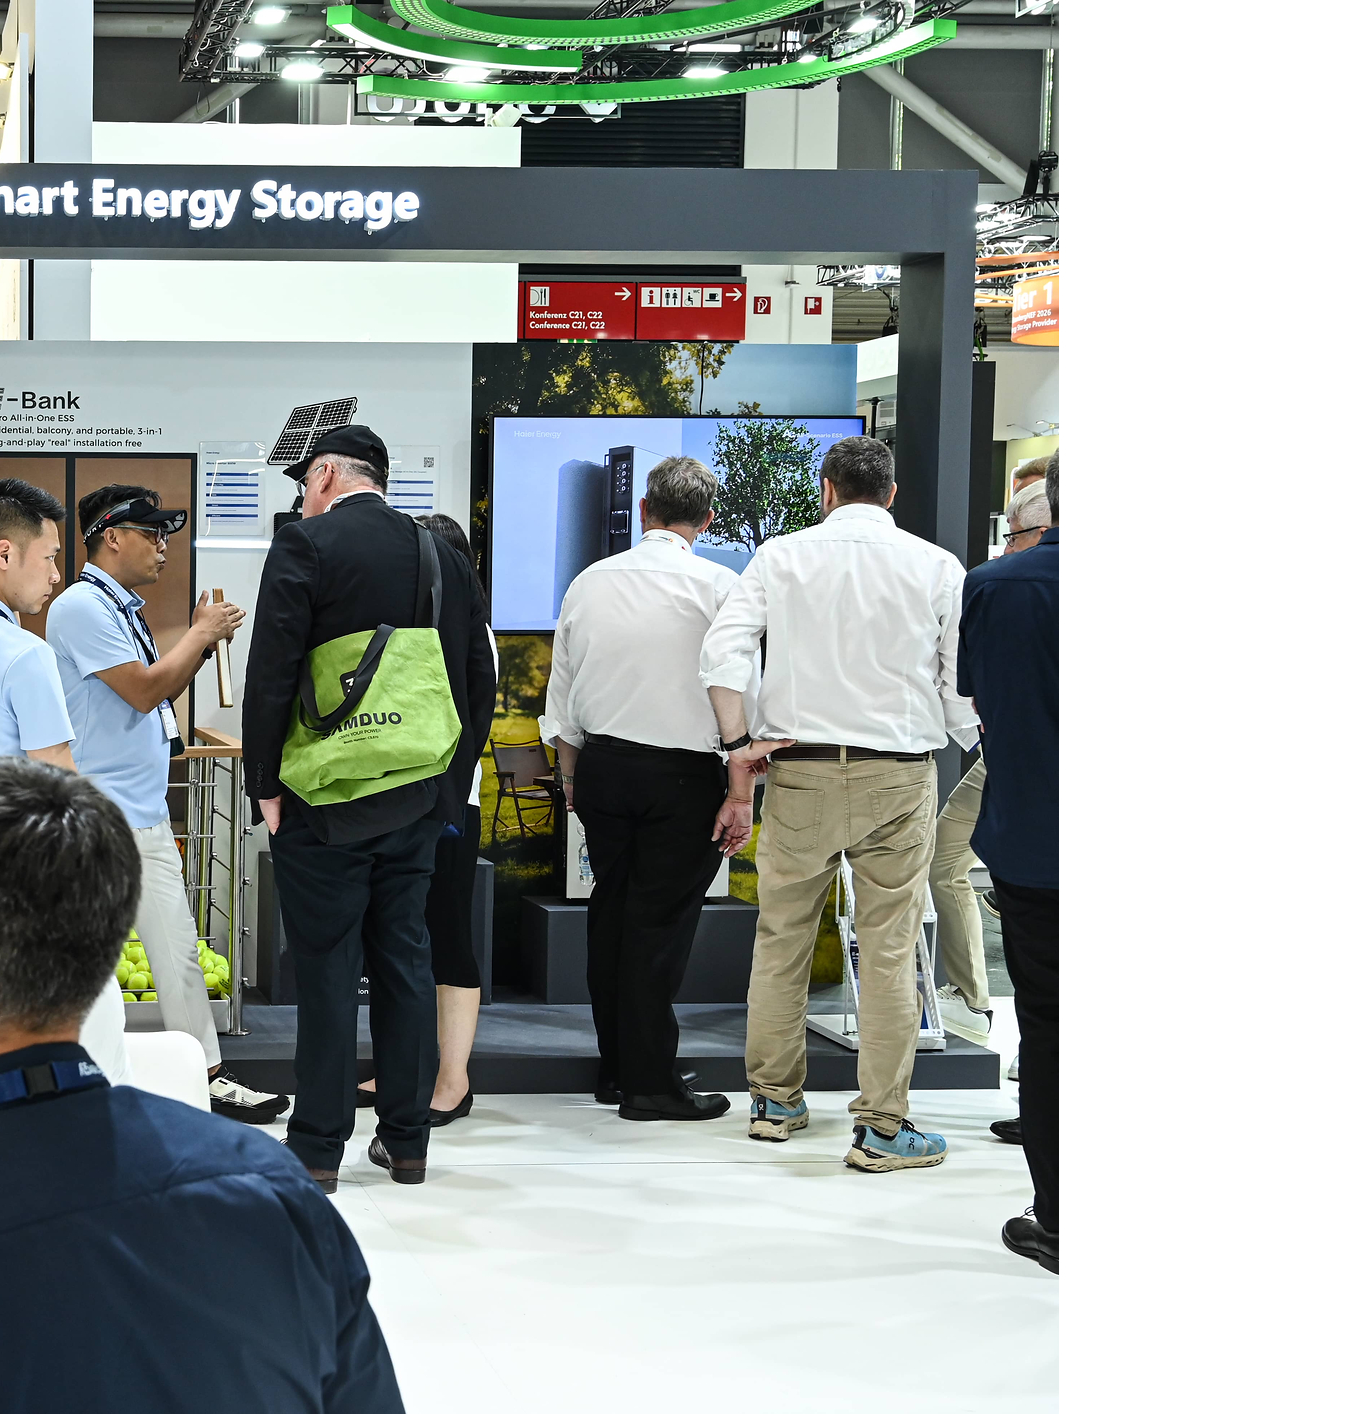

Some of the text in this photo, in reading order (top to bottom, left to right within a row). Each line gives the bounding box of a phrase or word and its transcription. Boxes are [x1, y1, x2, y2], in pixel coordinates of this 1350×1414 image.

[92, 178, 241, 230] Energy
[251, 180, 420, 231] Storage
[1043, 281, 1053, 305] 1
[529, 311, 603, 321] Konferenz C21, C22
[529, 321, 605, 331] Conference C21, C22
[10, 414, 56, 422] All-in-One
[57, 414, 75, 422] ESS
[36, 426, 74, 436] balcony,
[76, 427, 93, 435] and
[96, 427, 135, 436] portable,
[137, 427, 162, 435] 3-in-1
[73, 439, 122, 447] installation
[125, 439, 143, 447] free
